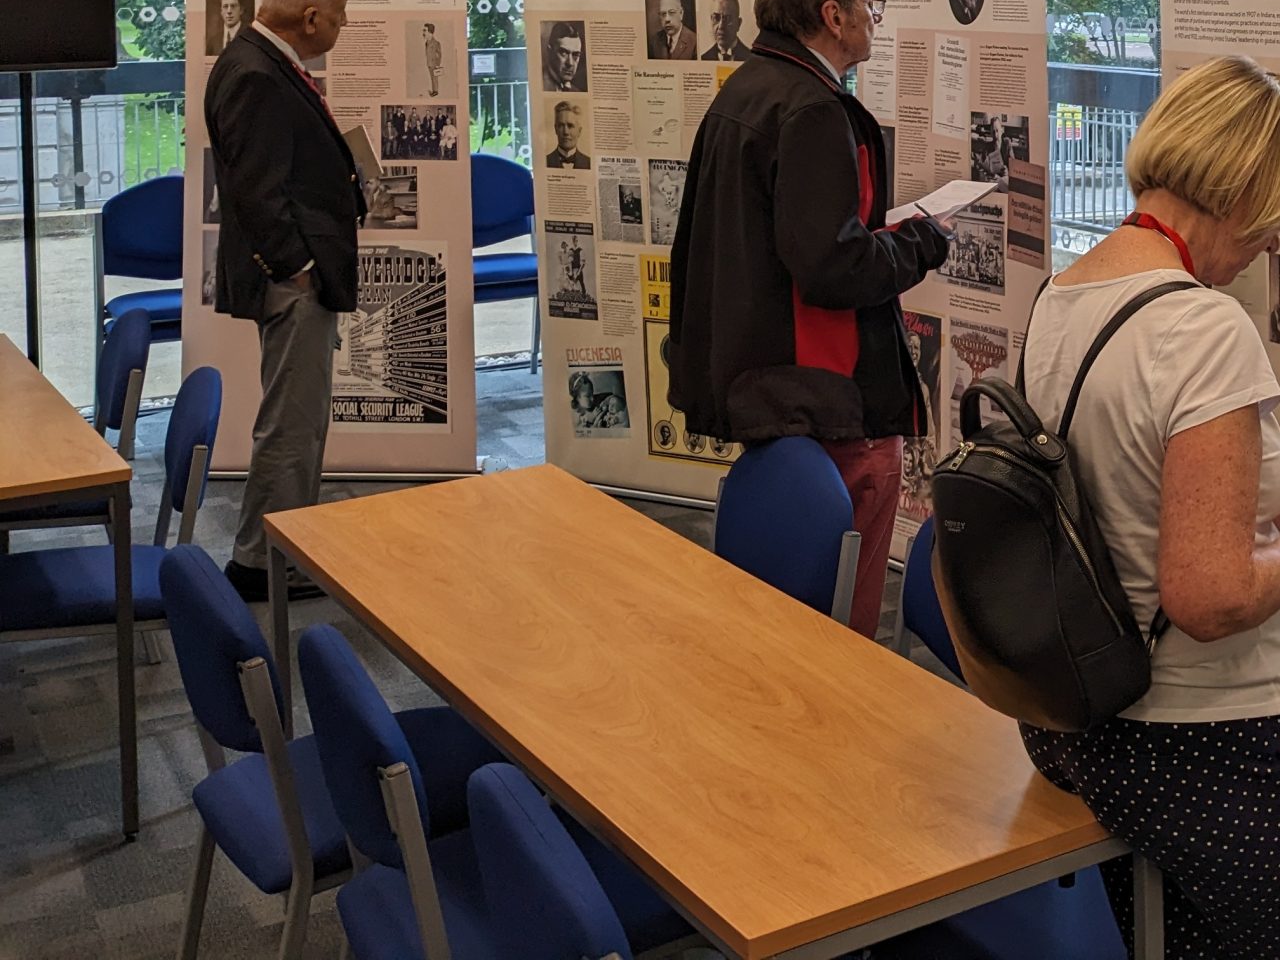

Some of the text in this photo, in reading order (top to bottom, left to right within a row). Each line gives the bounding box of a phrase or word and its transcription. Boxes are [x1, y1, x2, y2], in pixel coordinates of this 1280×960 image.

[358, 253, 442, 285] VERIDGE'
[333, 402, 424, 416] SOCIAL SECURITY LEAGUE
